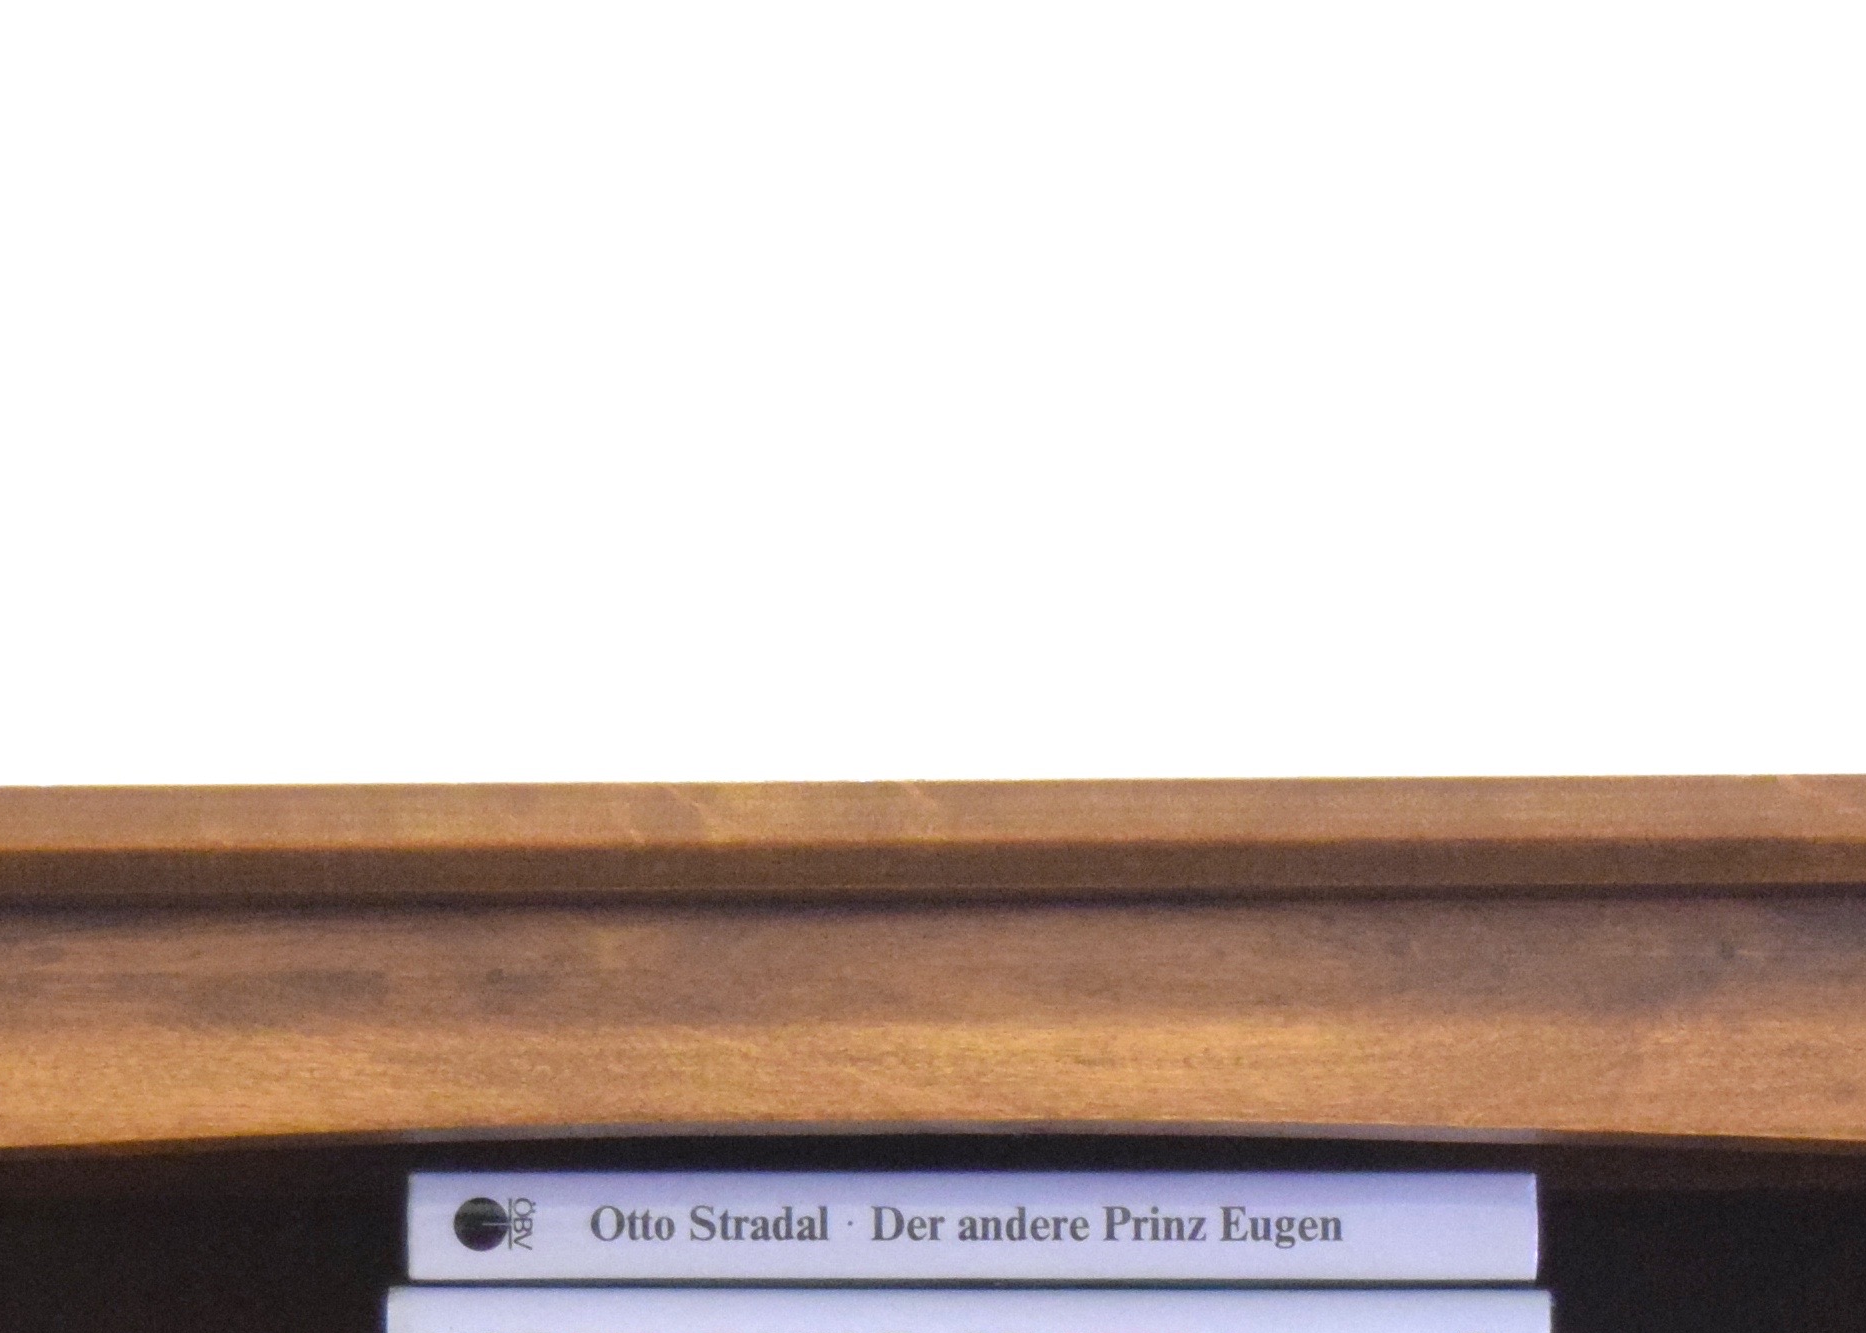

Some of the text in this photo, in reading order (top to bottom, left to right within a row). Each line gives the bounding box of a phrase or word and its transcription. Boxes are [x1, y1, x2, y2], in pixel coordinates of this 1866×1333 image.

[513, 1197, 537, 1251] ÖBV
[589, 1204, 1344, 1250] Otto Stradal Der andere Prinz Eugen
